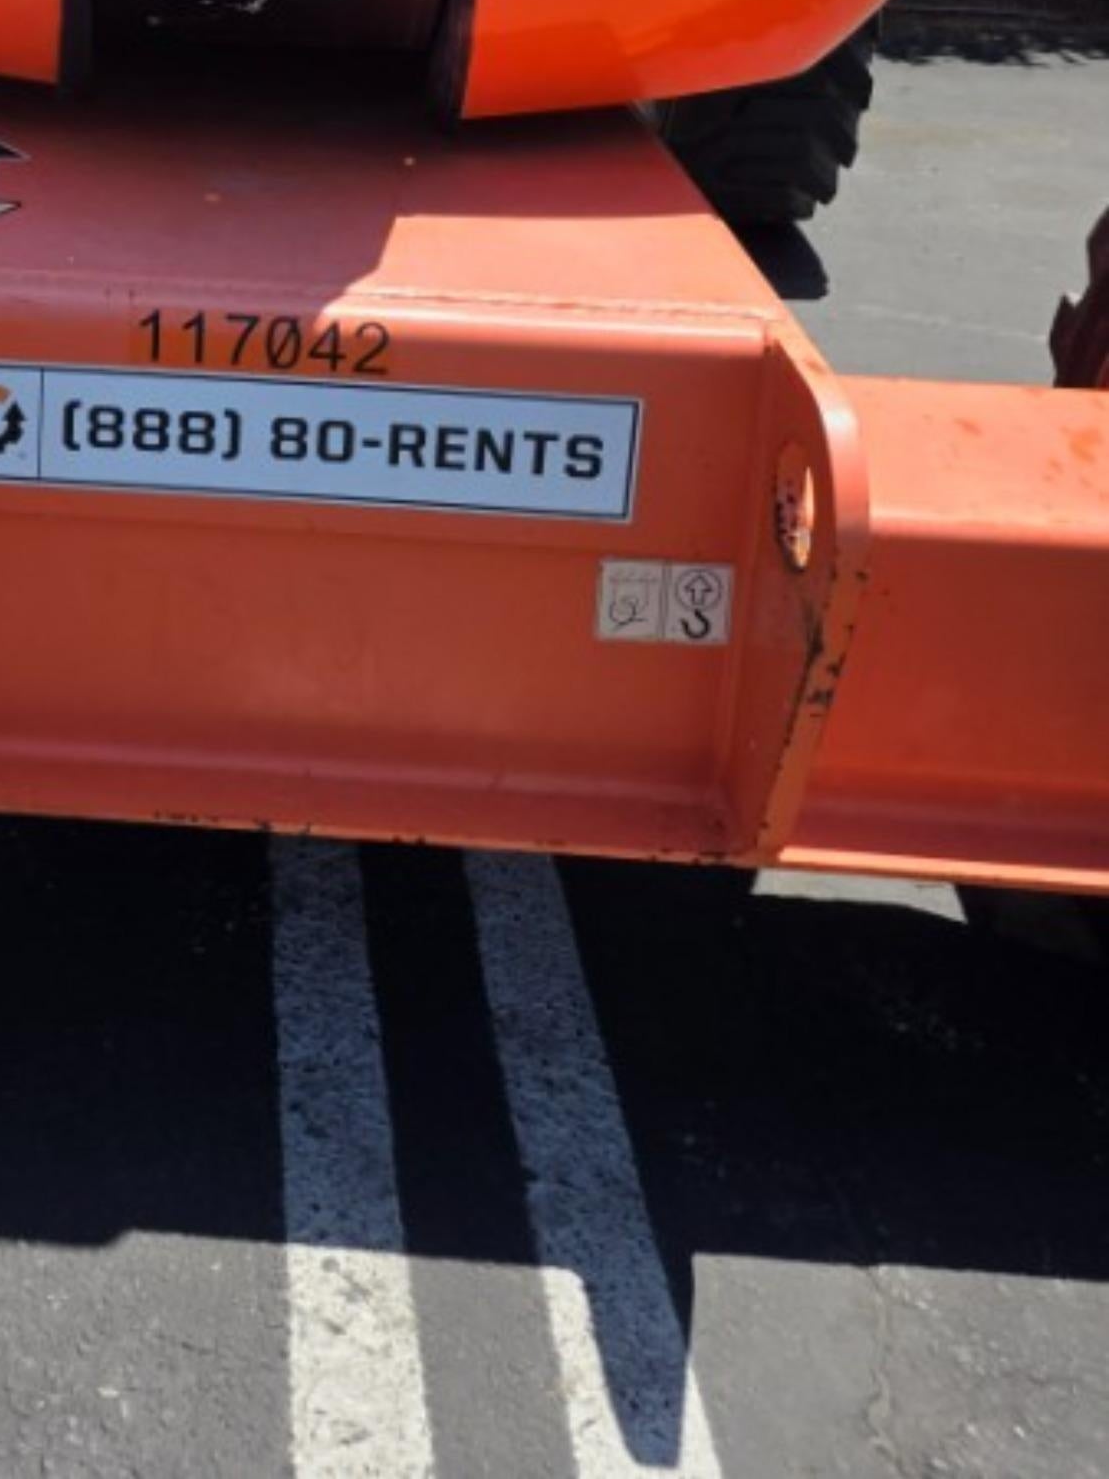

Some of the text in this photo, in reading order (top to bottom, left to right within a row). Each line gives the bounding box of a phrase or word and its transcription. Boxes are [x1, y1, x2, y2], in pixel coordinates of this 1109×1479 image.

[139, 309, 390, 375] 117042
[61, 399, 605, 481] (888) 80-RENTS
